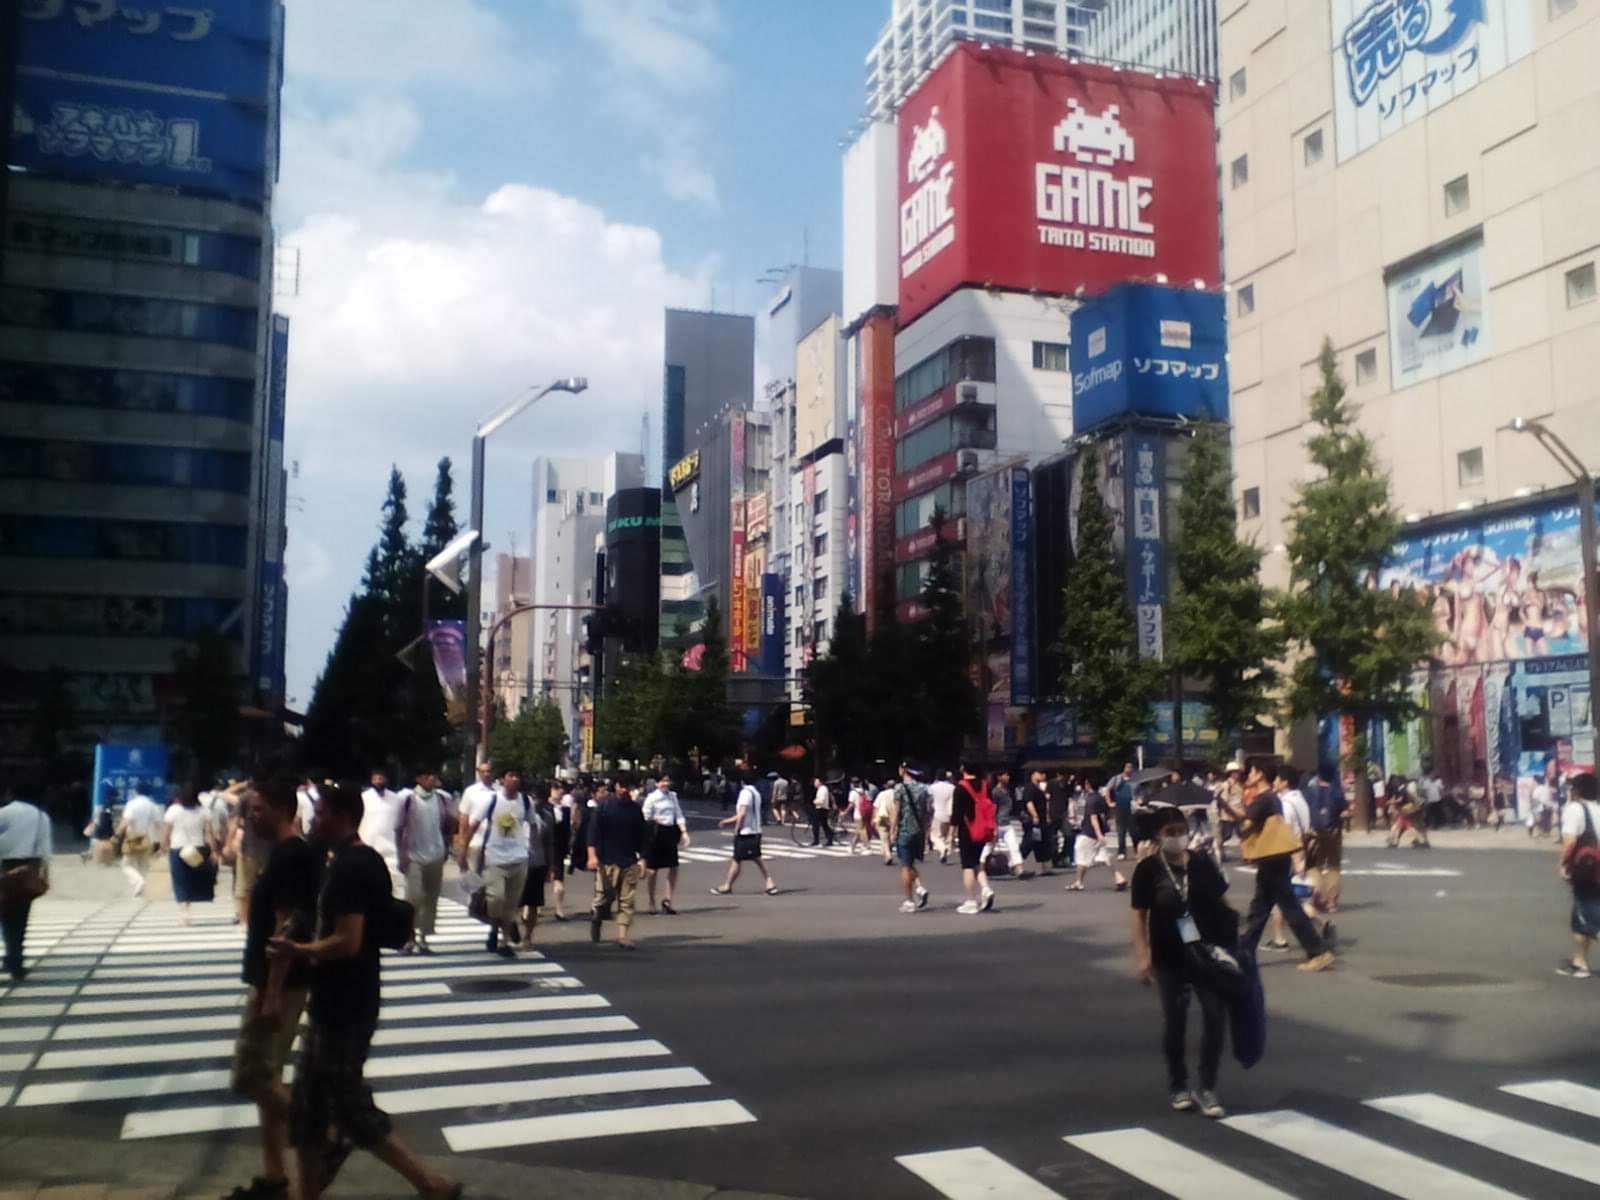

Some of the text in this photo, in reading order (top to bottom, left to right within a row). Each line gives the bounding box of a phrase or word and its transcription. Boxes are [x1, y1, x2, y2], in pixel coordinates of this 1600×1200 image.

[1379, 44, 1479, 119] ソフマップ
[1035, 162, 1154, 234] GAME
[1037, 225, 1155, 257] TAITO STATION
[1074, 359, 1122, 395] Sofmap
[1133, 356, 1219, 380] ソフマップ
